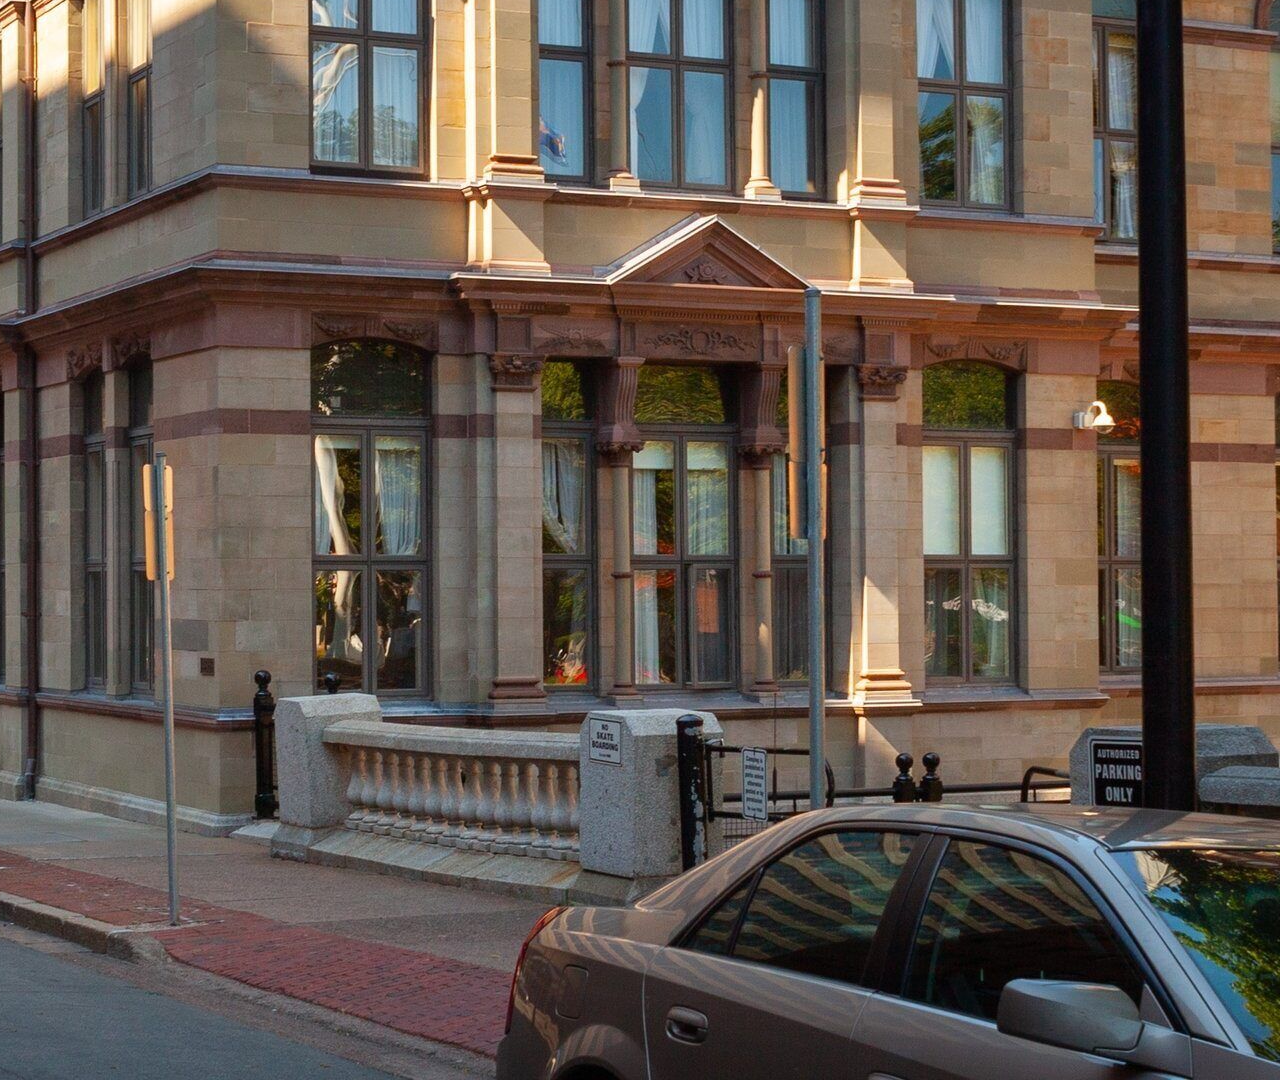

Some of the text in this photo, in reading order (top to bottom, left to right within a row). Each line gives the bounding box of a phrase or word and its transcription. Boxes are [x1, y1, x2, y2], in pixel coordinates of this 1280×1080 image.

[596, 731, 614, 741] SKATE
[591, 740, 619, 752] BOARDING
[1097, 749, 1140, 760] AUTHORIZED
[1095, 763, 1142, 781] PARKING
[1105, 786, 1133, 802] ONLY
